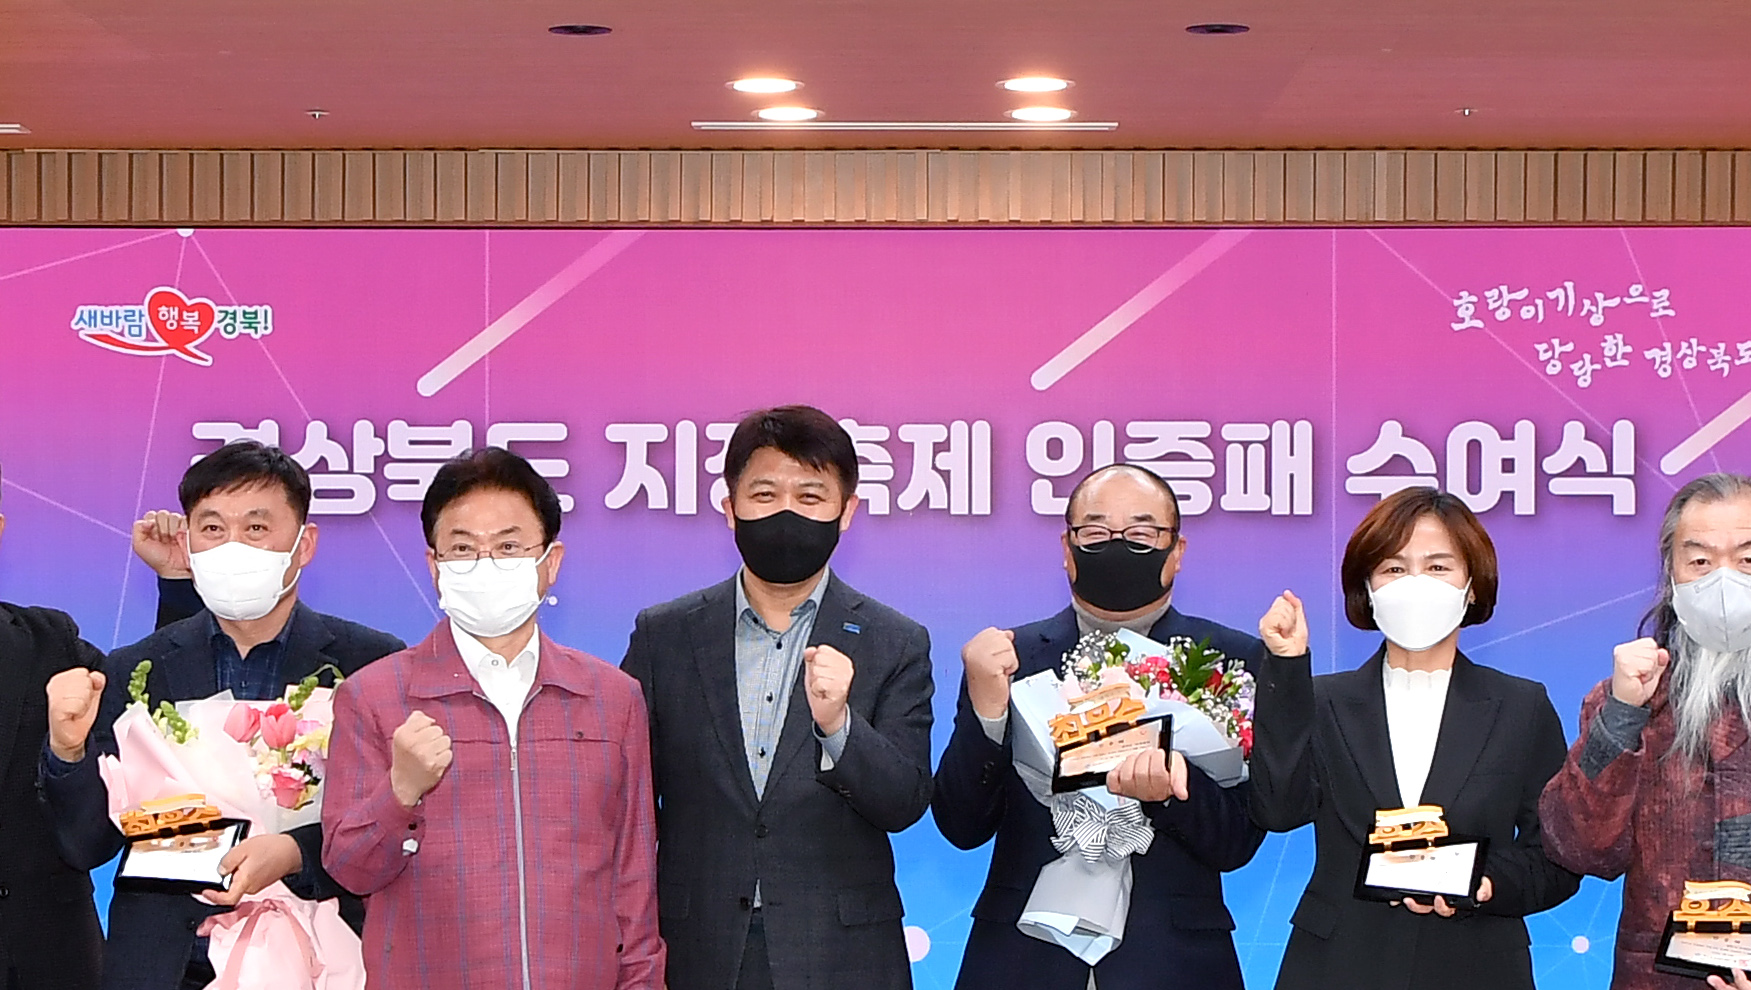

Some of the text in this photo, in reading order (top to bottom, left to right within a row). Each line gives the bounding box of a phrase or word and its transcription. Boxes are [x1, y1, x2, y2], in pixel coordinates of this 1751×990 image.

[74, 305, 270, 338] 새바람 행복 경북!
[1534, 333, 1634, 388] 당당한
[1026, 420, 1313, 516] 인증패
[1345, 419, 1636, 516] 수여식
